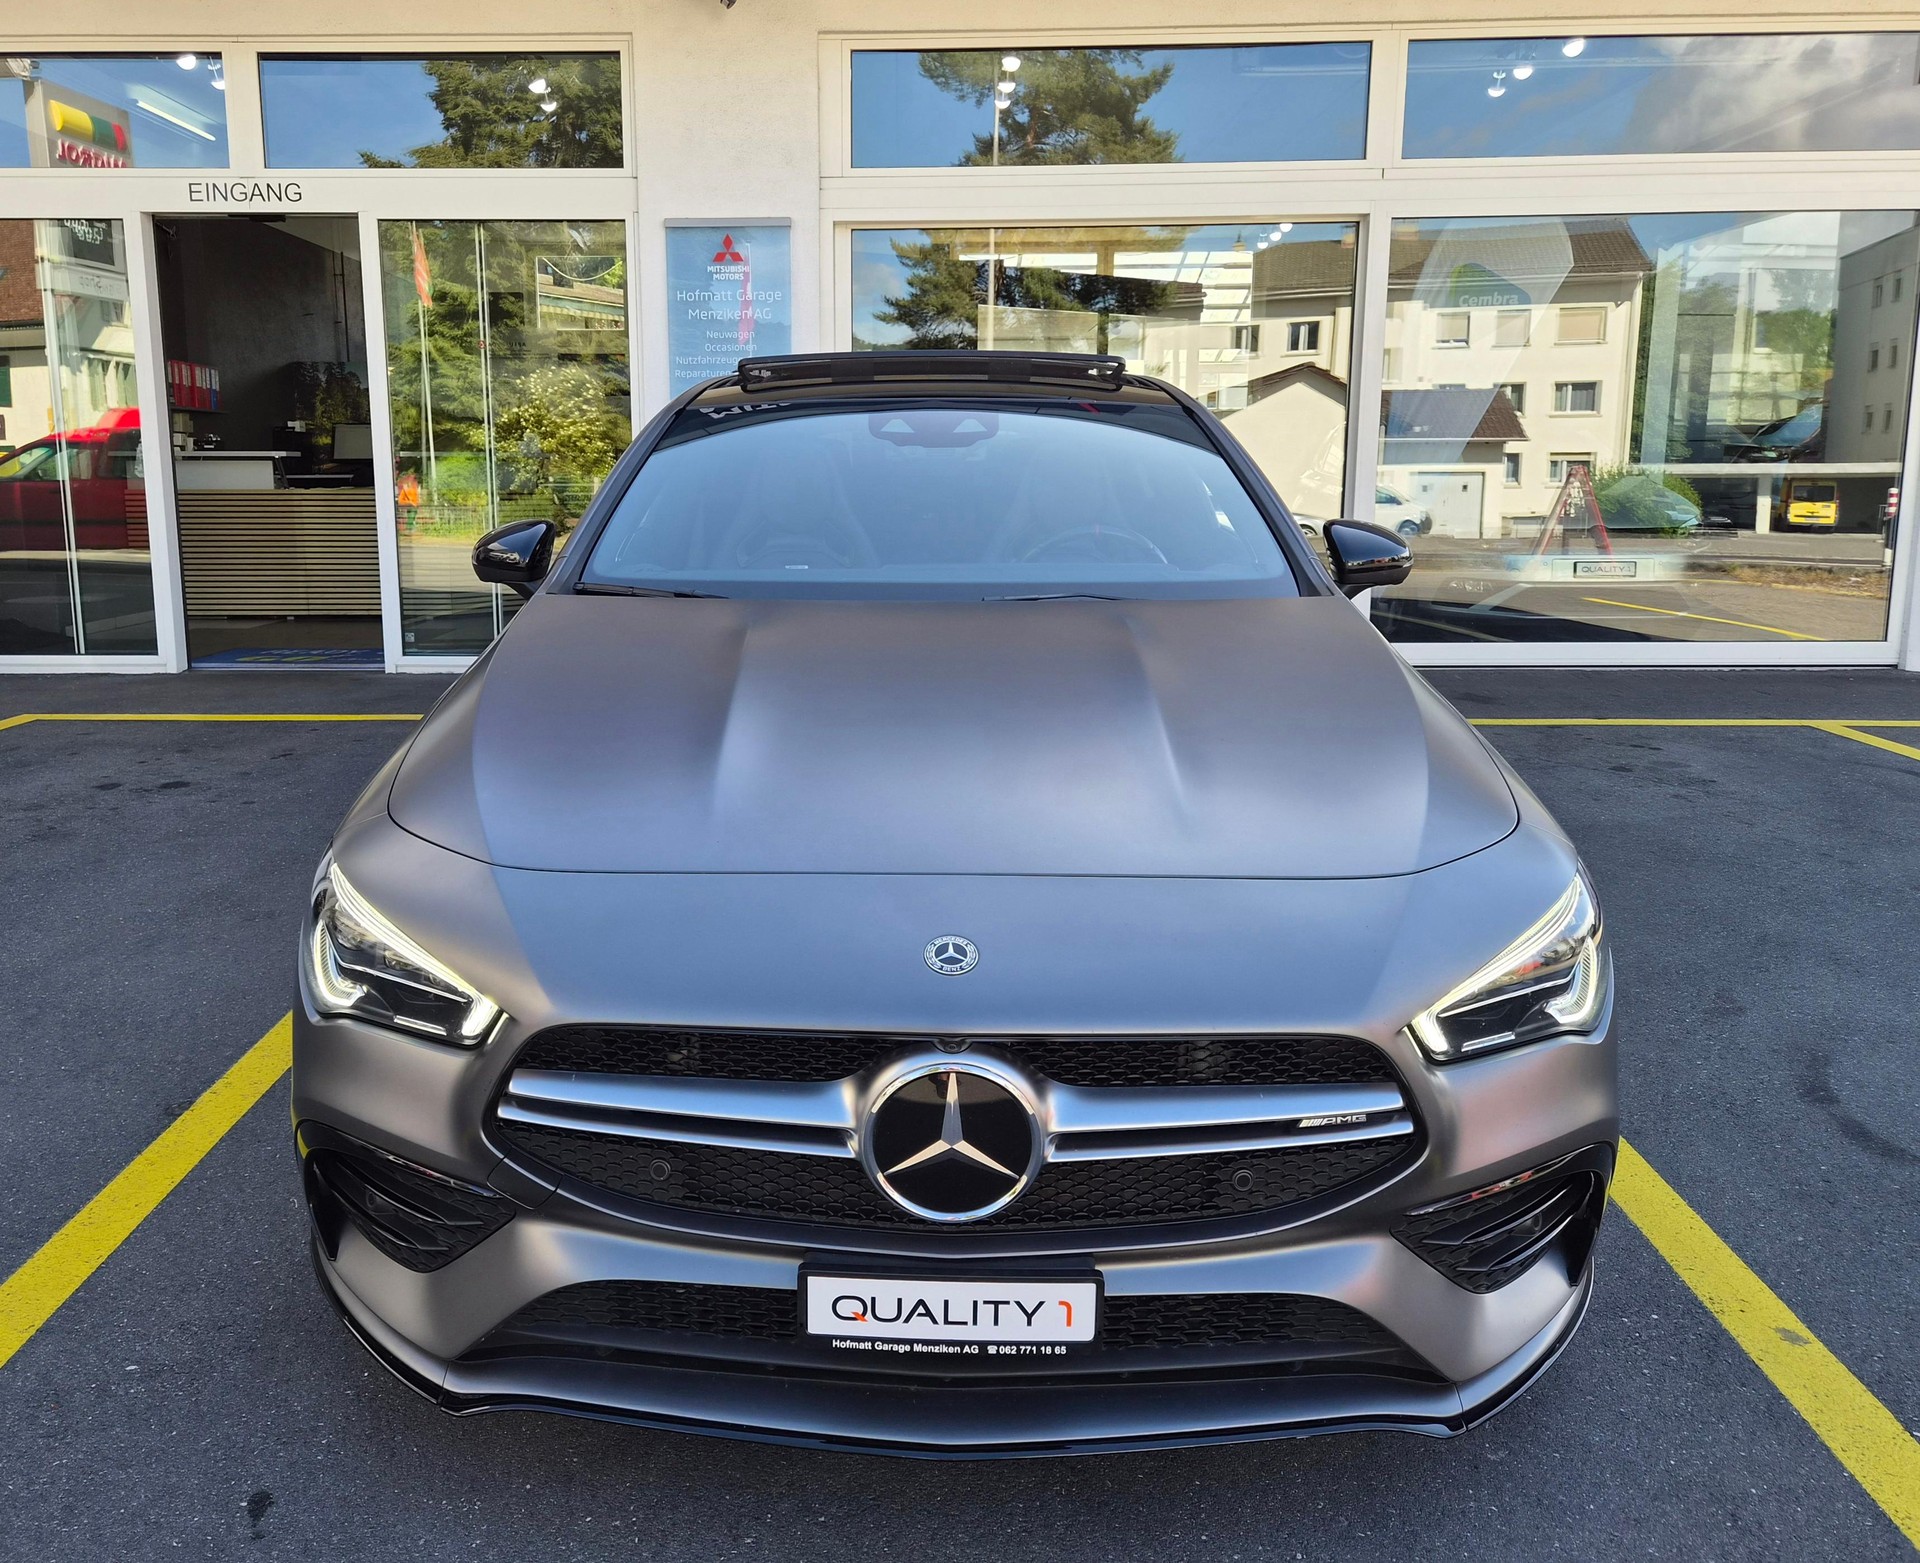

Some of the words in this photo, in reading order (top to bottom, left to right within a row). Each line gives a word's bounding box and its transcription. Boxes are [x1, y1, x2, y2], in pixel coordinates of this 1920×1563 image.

[188, 182, 303, 203] EINGANG
[707, 265, 750, 273] MITSUBISHI
[676, 290, 732, 301] Hofmatt
[736, 289, 782, 303] Garage
[1458, 291, 1519, 307] Cembra
[688, 309, 751, 320] Menziken
[754, 308, 772, 319] AG
[706, 331, 755, 341] Neuwagen
[704, 343, 757, 351] Occasionen
[676, 356, 741, 366] Nutzfahrzeug
[675, 370, 731, 378] Reparaturen
[1581, 565, 1624, 573] QUALITY
[831, 1294, 1046, 1327] QUALITY
[1058, 1300, 1073, 1327] 1
[832, 1339, 872, 1350] Hofmatt
[874, 1341, 911, 1353] Garage
[913, 1343, 961, 1354] Menziken
[962, 1345, 979, 1354] AG
[999, 1346, 1017, 1355] 062
[1020, 1346, 1037, 1355] 771
[1040, 1346, 1052, 1355] 18
[1054, 1346, 1067, 1355] 65
